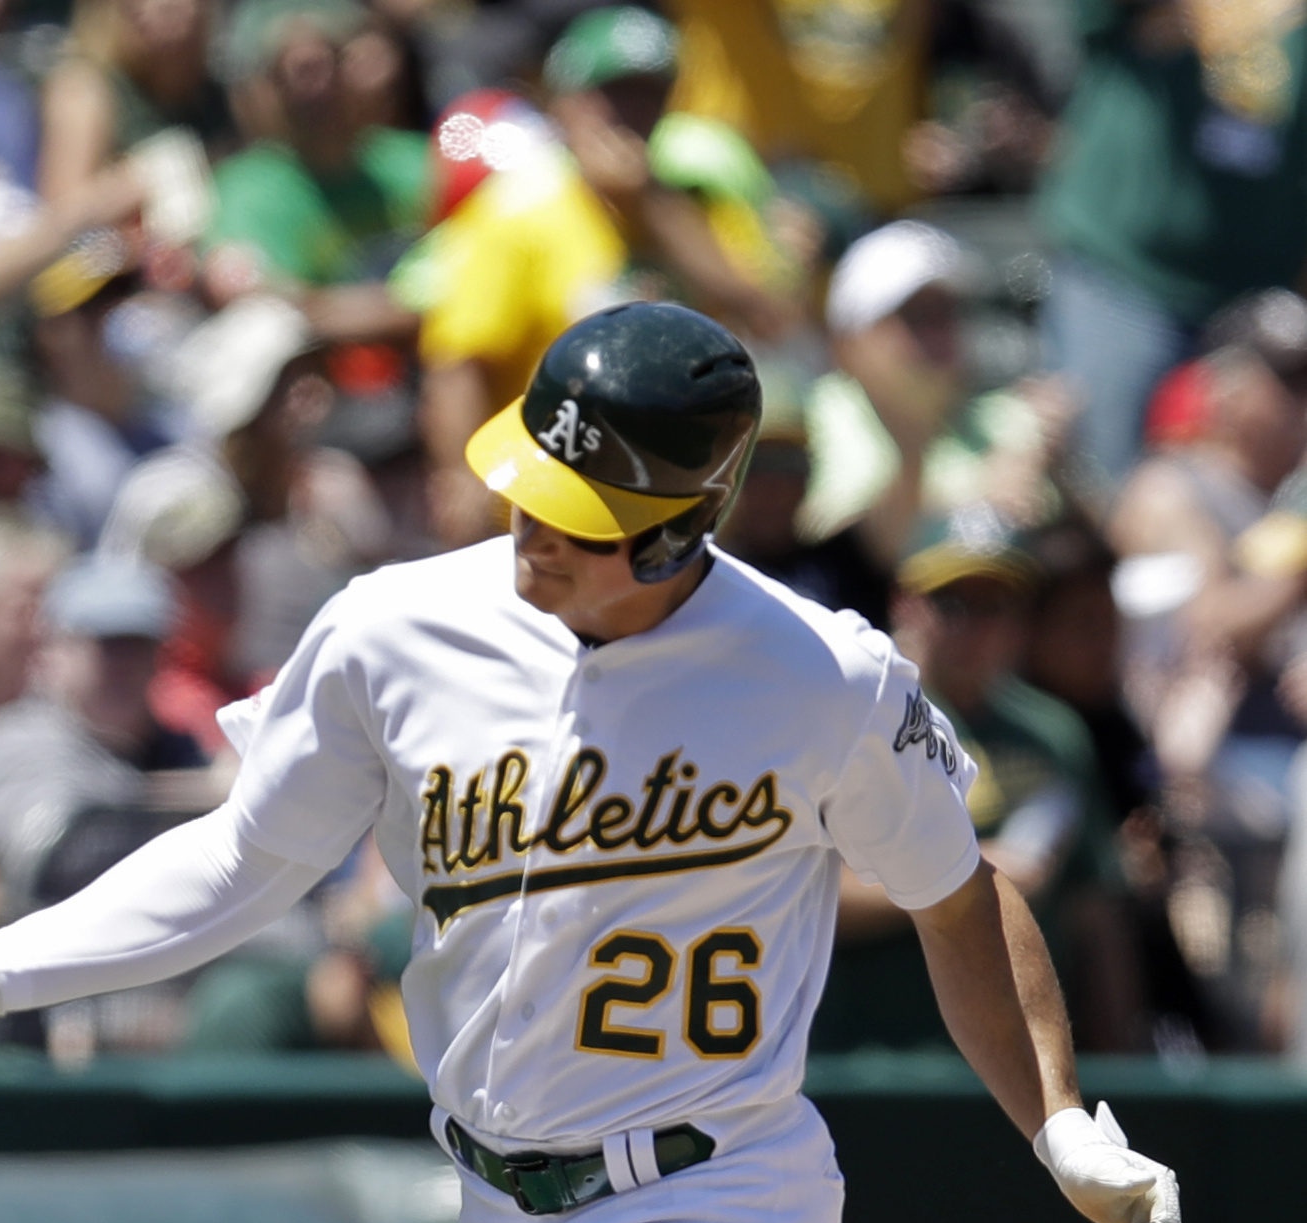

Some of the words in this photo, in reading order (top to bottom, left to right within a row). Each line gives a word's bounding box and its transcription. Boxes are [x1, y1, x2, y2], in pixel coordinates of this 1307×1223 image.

[537, 399, 602, 461] A's
[420, 745, 792, 878] Athletics
[574, 926, 764, 1061] 26
